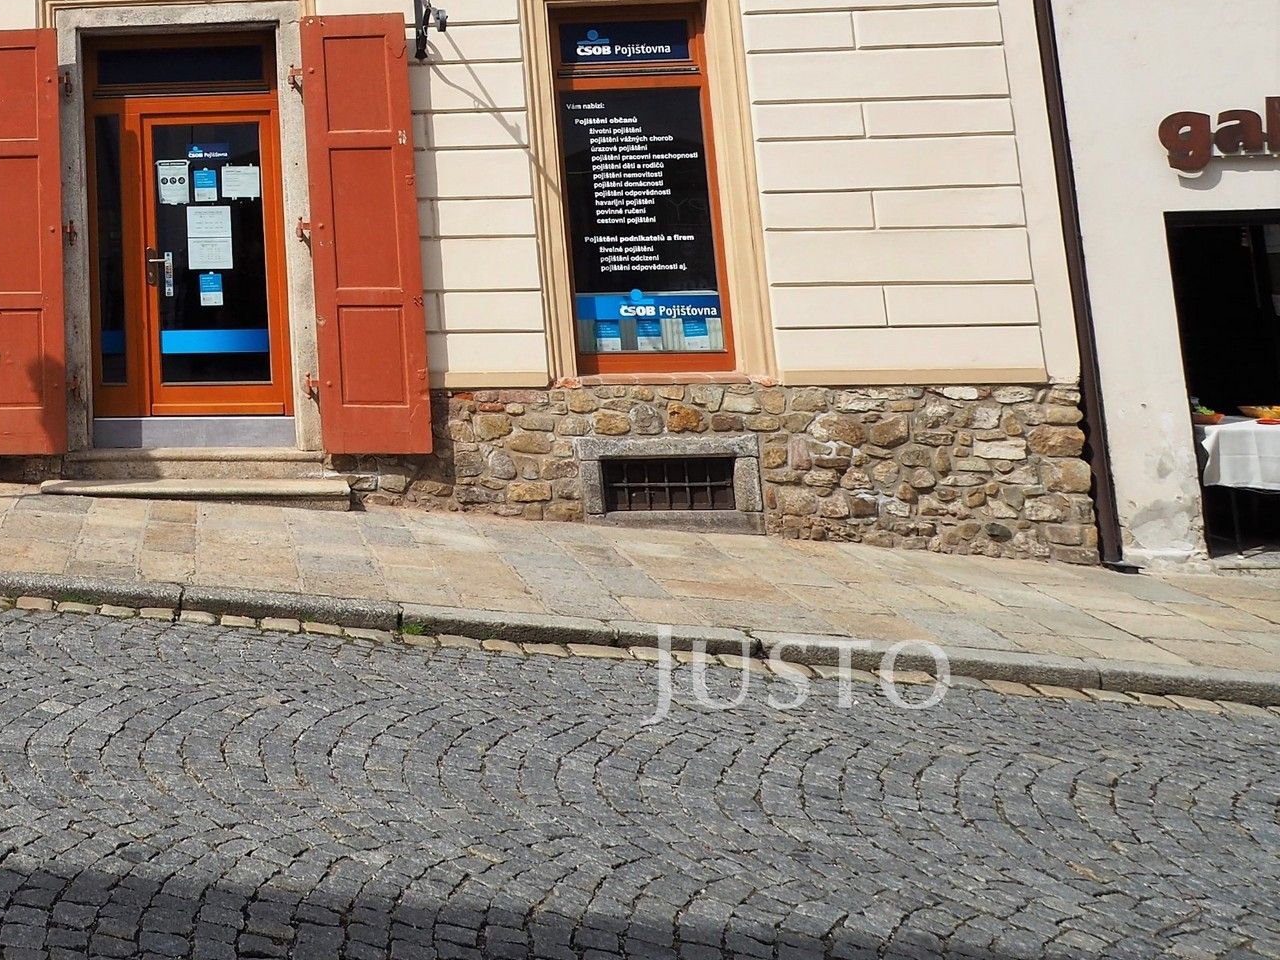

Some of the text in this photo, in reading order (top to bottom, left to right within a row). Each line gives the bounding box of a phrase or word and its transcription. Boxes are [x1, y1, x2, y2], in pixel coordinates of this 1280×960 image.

[576, 43, 672, 57] ČSOB Pojišťovna
[609, 116, 638, 124] občanů
[620, 304, 717, 318] ČSOB Pojišťovna
